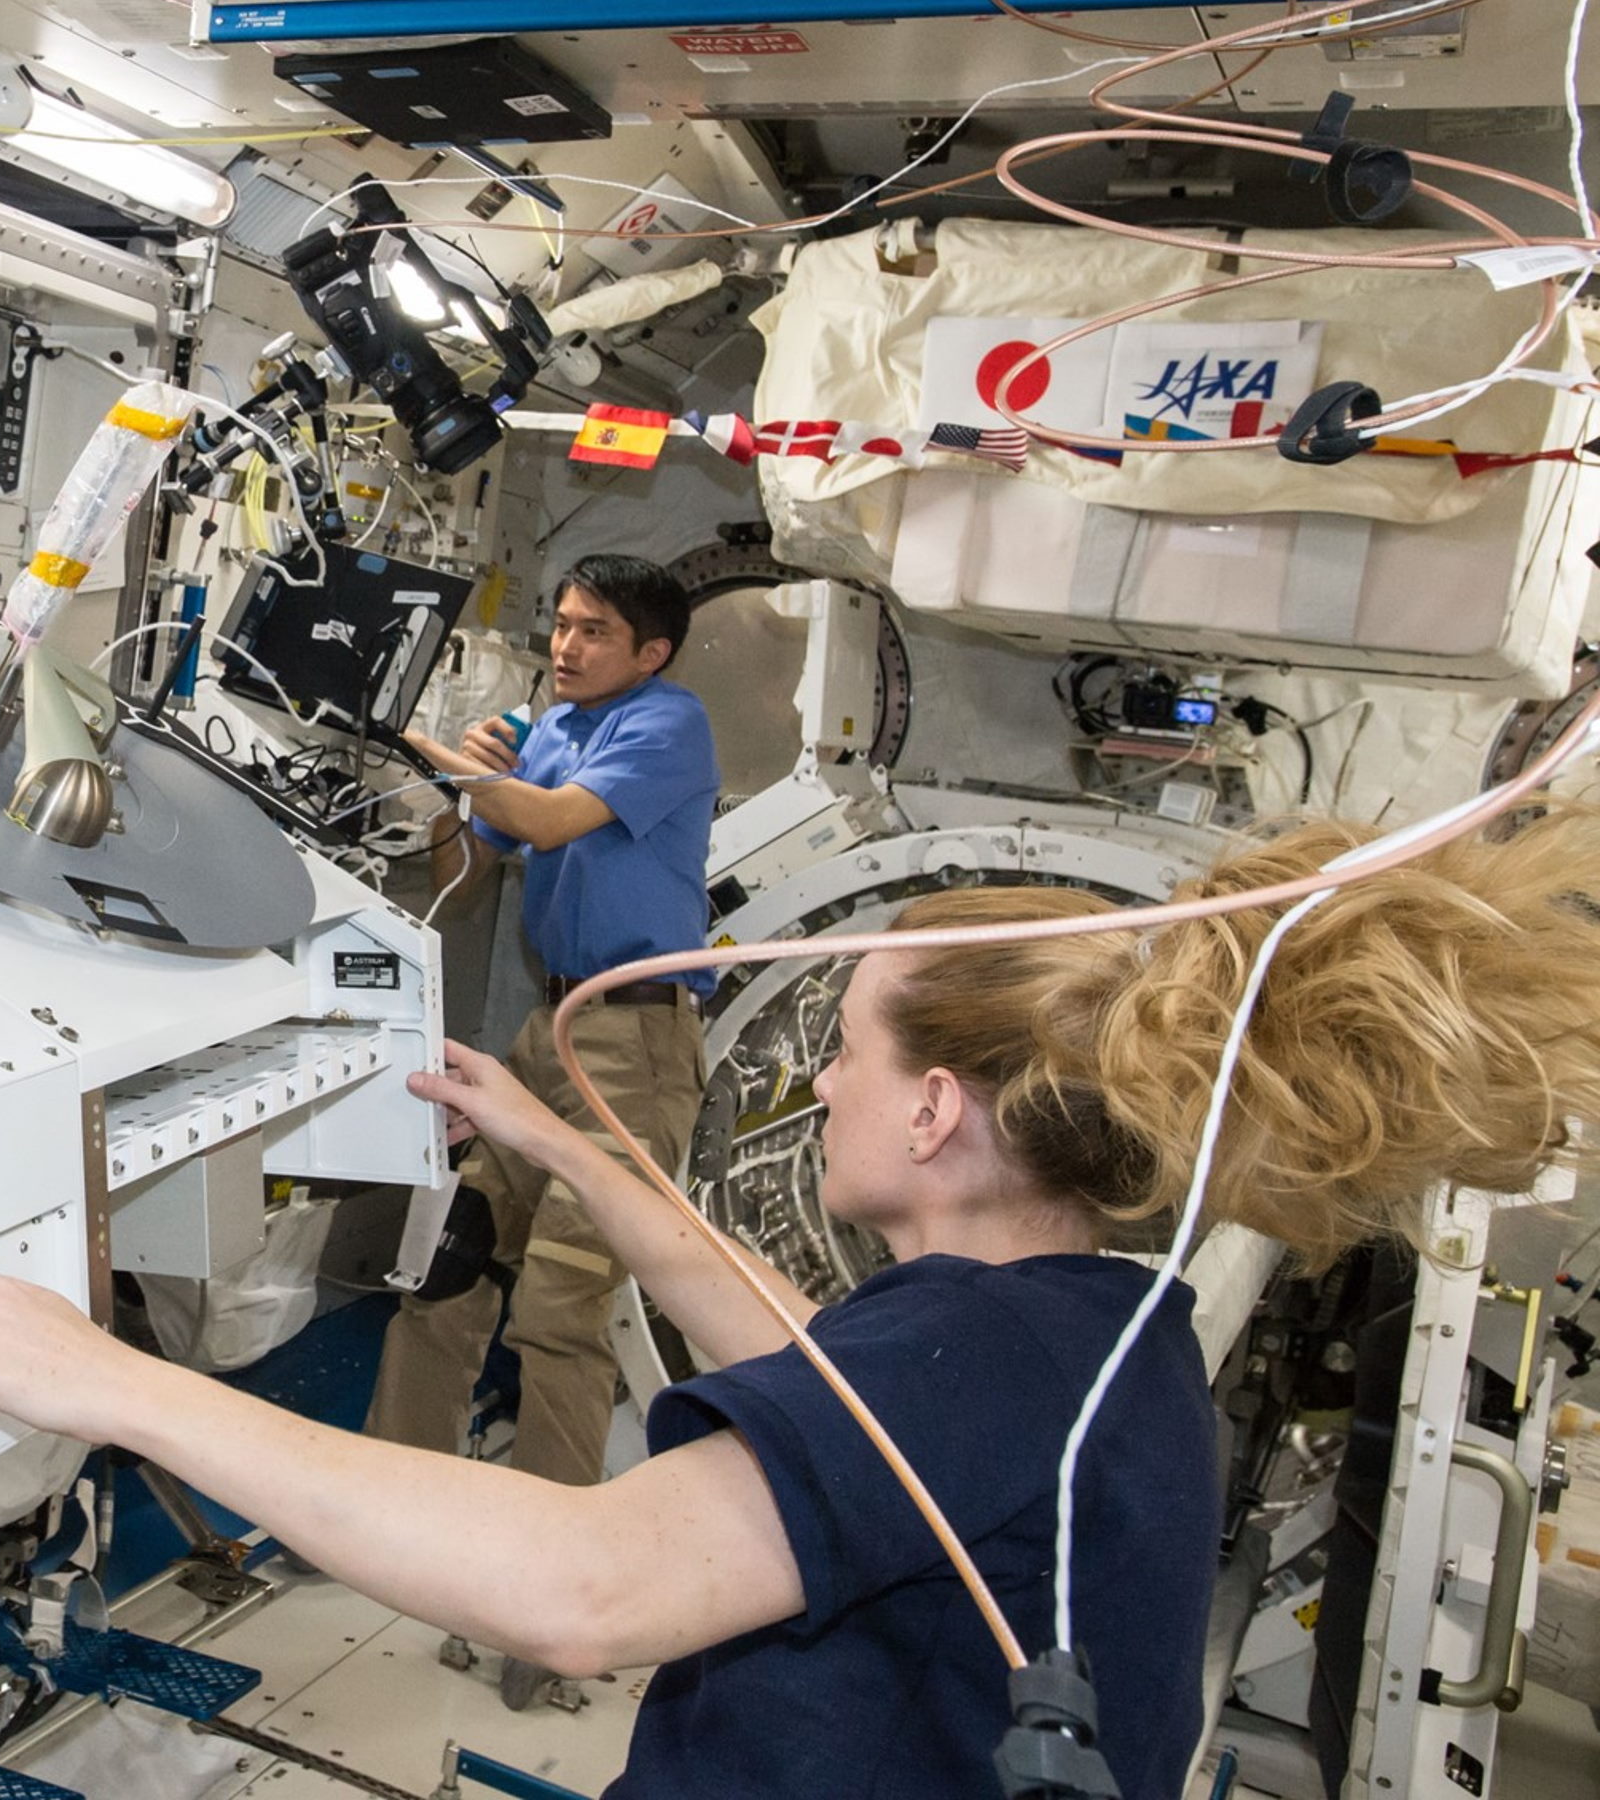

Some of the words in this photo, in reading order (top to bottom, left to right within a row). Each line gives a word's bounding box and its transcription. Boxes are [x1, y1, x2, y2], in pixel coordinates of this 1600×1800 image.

[685, 44, 744, 52] MIST
[686, 36, 784, 45] WATER
[360, 305, 377, 336] Canon
[1132, 351, 1280, 420] JAXA
